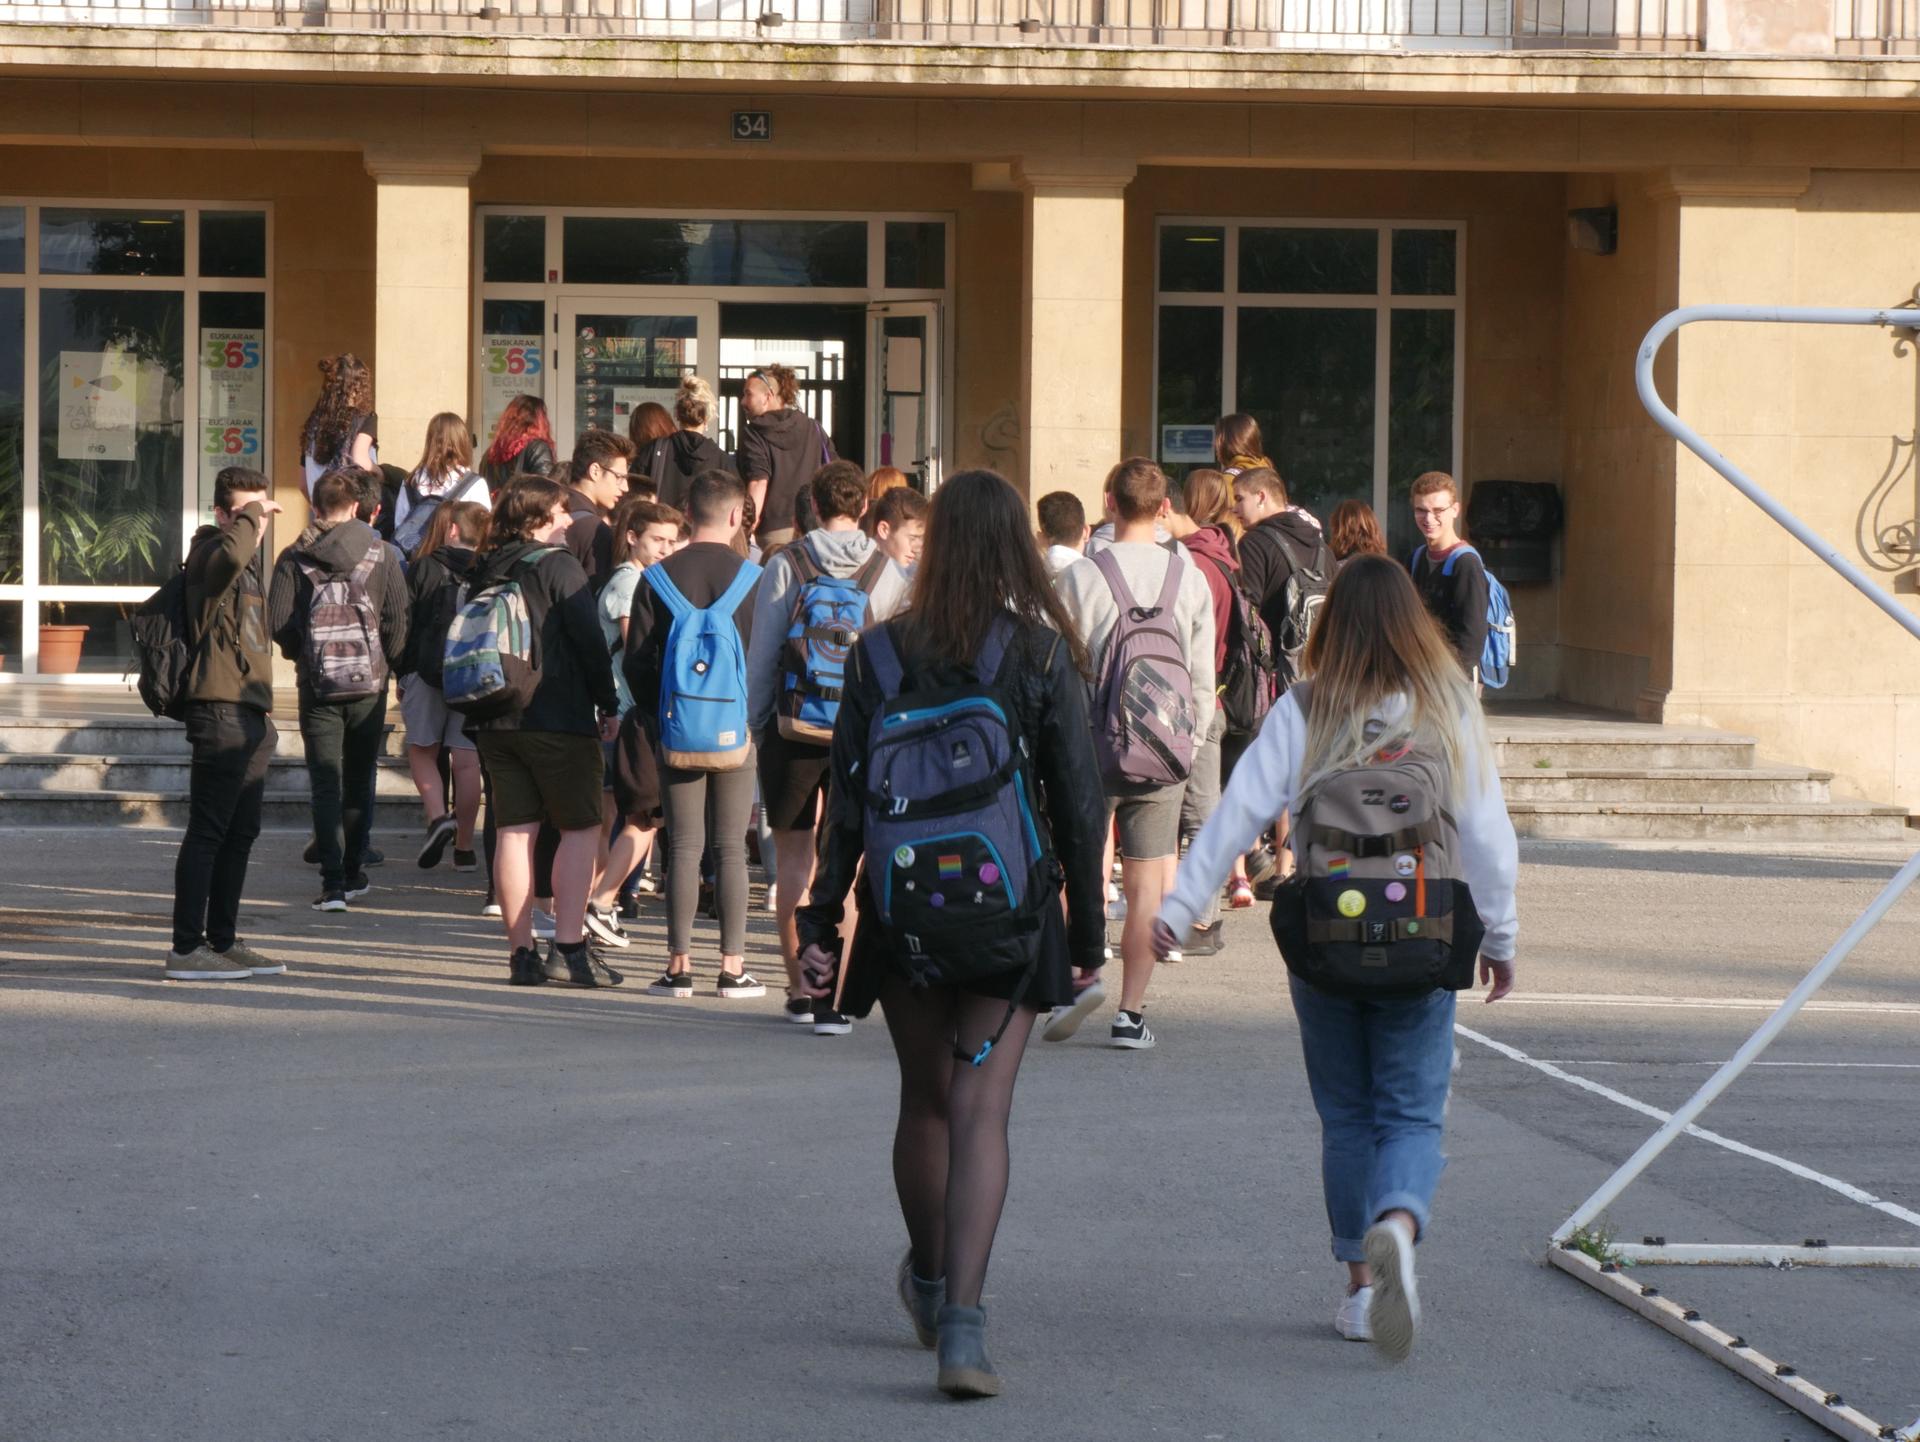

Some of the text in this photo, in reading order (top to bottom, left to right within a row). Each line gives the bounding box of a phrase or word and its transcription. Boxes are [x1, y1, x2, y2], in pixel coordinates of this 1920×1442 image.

[737, 115, 767, 137] 34
[209, 332, 255, 340] EUSKARAK
[491, 339, 536, 347] EUSKARAK
[206, 341, 260, 369] 365
[488, 347, 541, 375] 365
[492, 377, 535, 388] EGUN
[204, 427, 258, 455] 365
